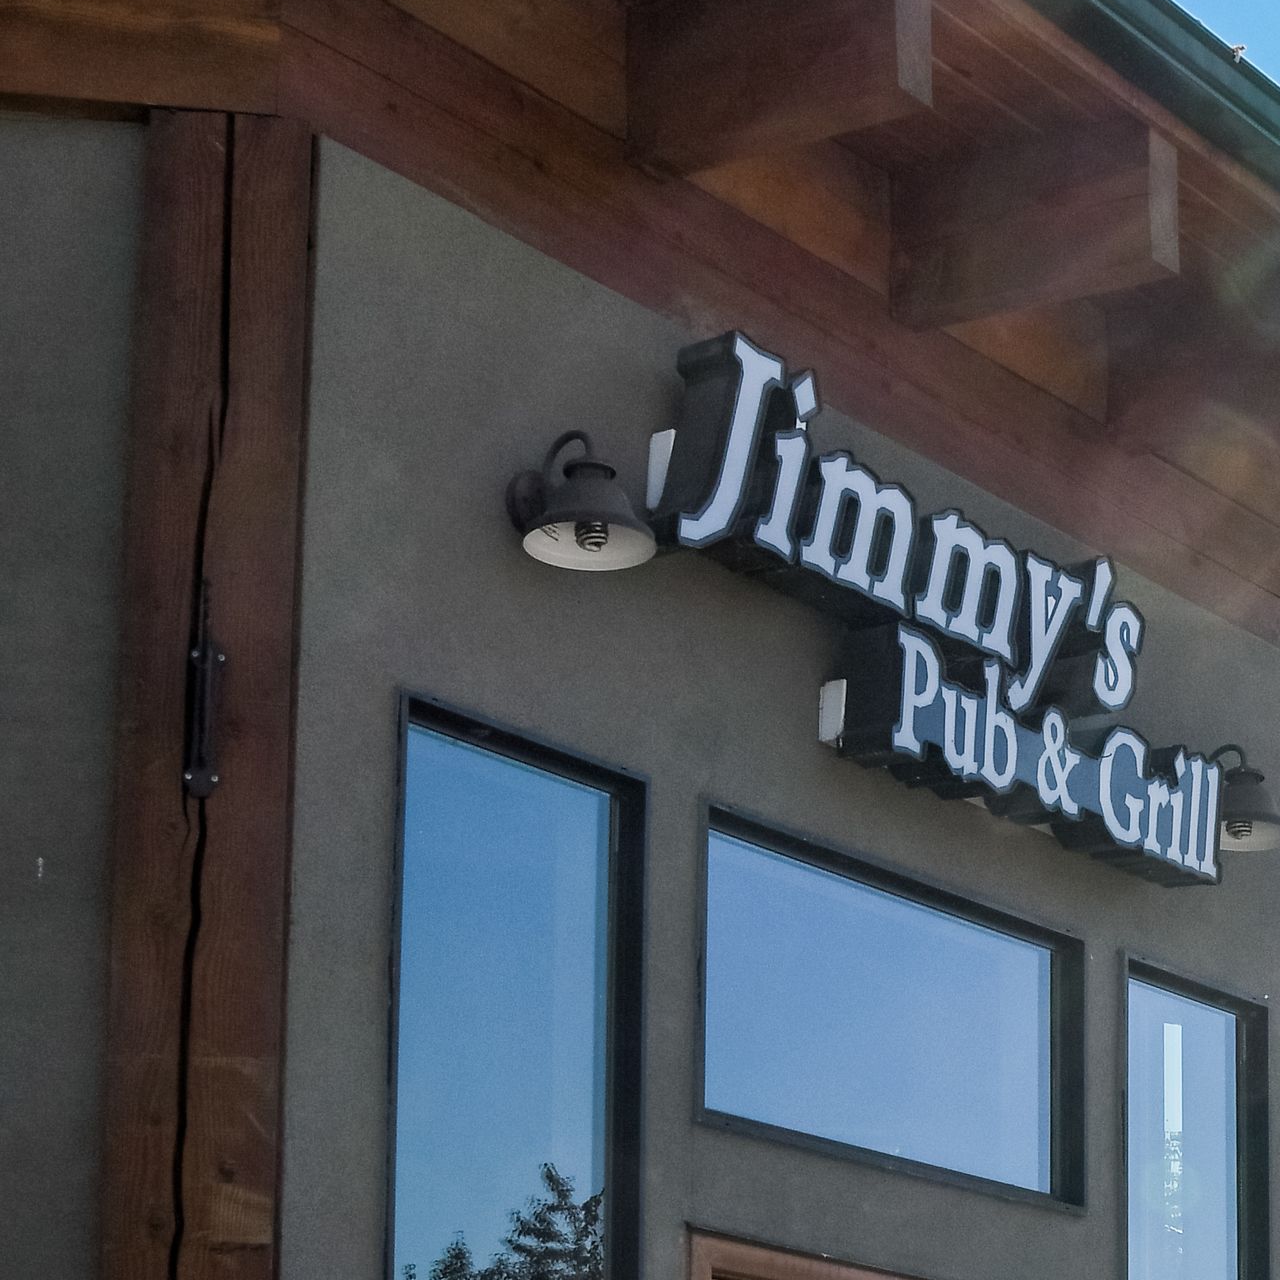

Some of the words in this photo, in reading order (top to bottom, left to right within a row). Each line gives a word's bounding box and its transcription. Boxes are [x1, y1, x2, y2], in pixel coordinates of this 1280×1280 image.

[678, 331, 1145, 711] Jimmy's
[893, 628, 1018, 792] Pub
[1036, 708, 1082, 815] &
[1099, 726, 1222, 880] Grill
